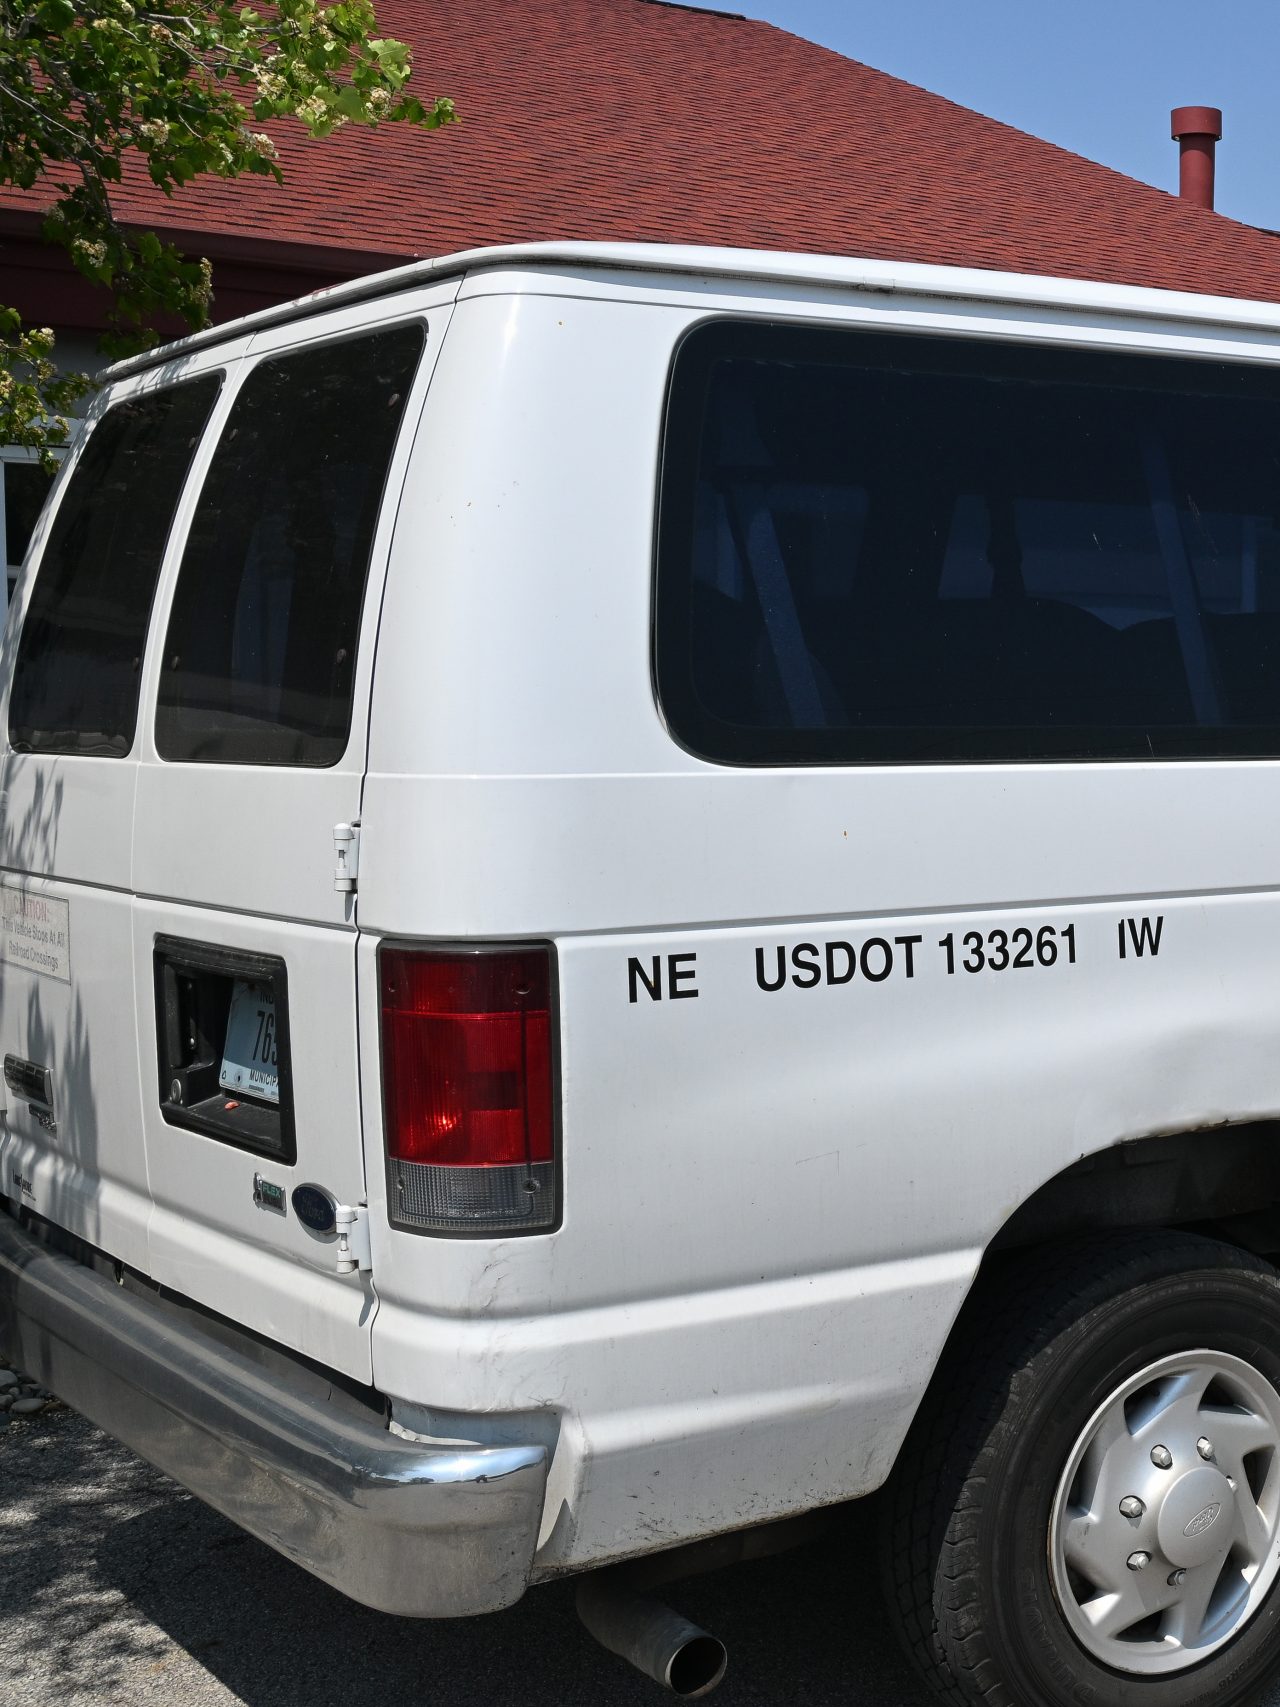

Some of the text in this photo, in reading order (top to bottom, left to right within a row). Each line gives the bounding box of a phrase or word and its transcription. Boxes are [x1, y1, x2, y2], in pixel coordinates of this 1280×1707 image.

[2, 916, 13, 932] This
[14, 919, 31, 938] Vehicle
[33, 924, 48, 945] Stops
[50, 930, 56, 945] At
[9, 940, 59, 972] Railroad Crossings
[627, 916, 1165, 1003] NE USDOT 133261 IW
[262, 1182, 281, 1199] FLEX
